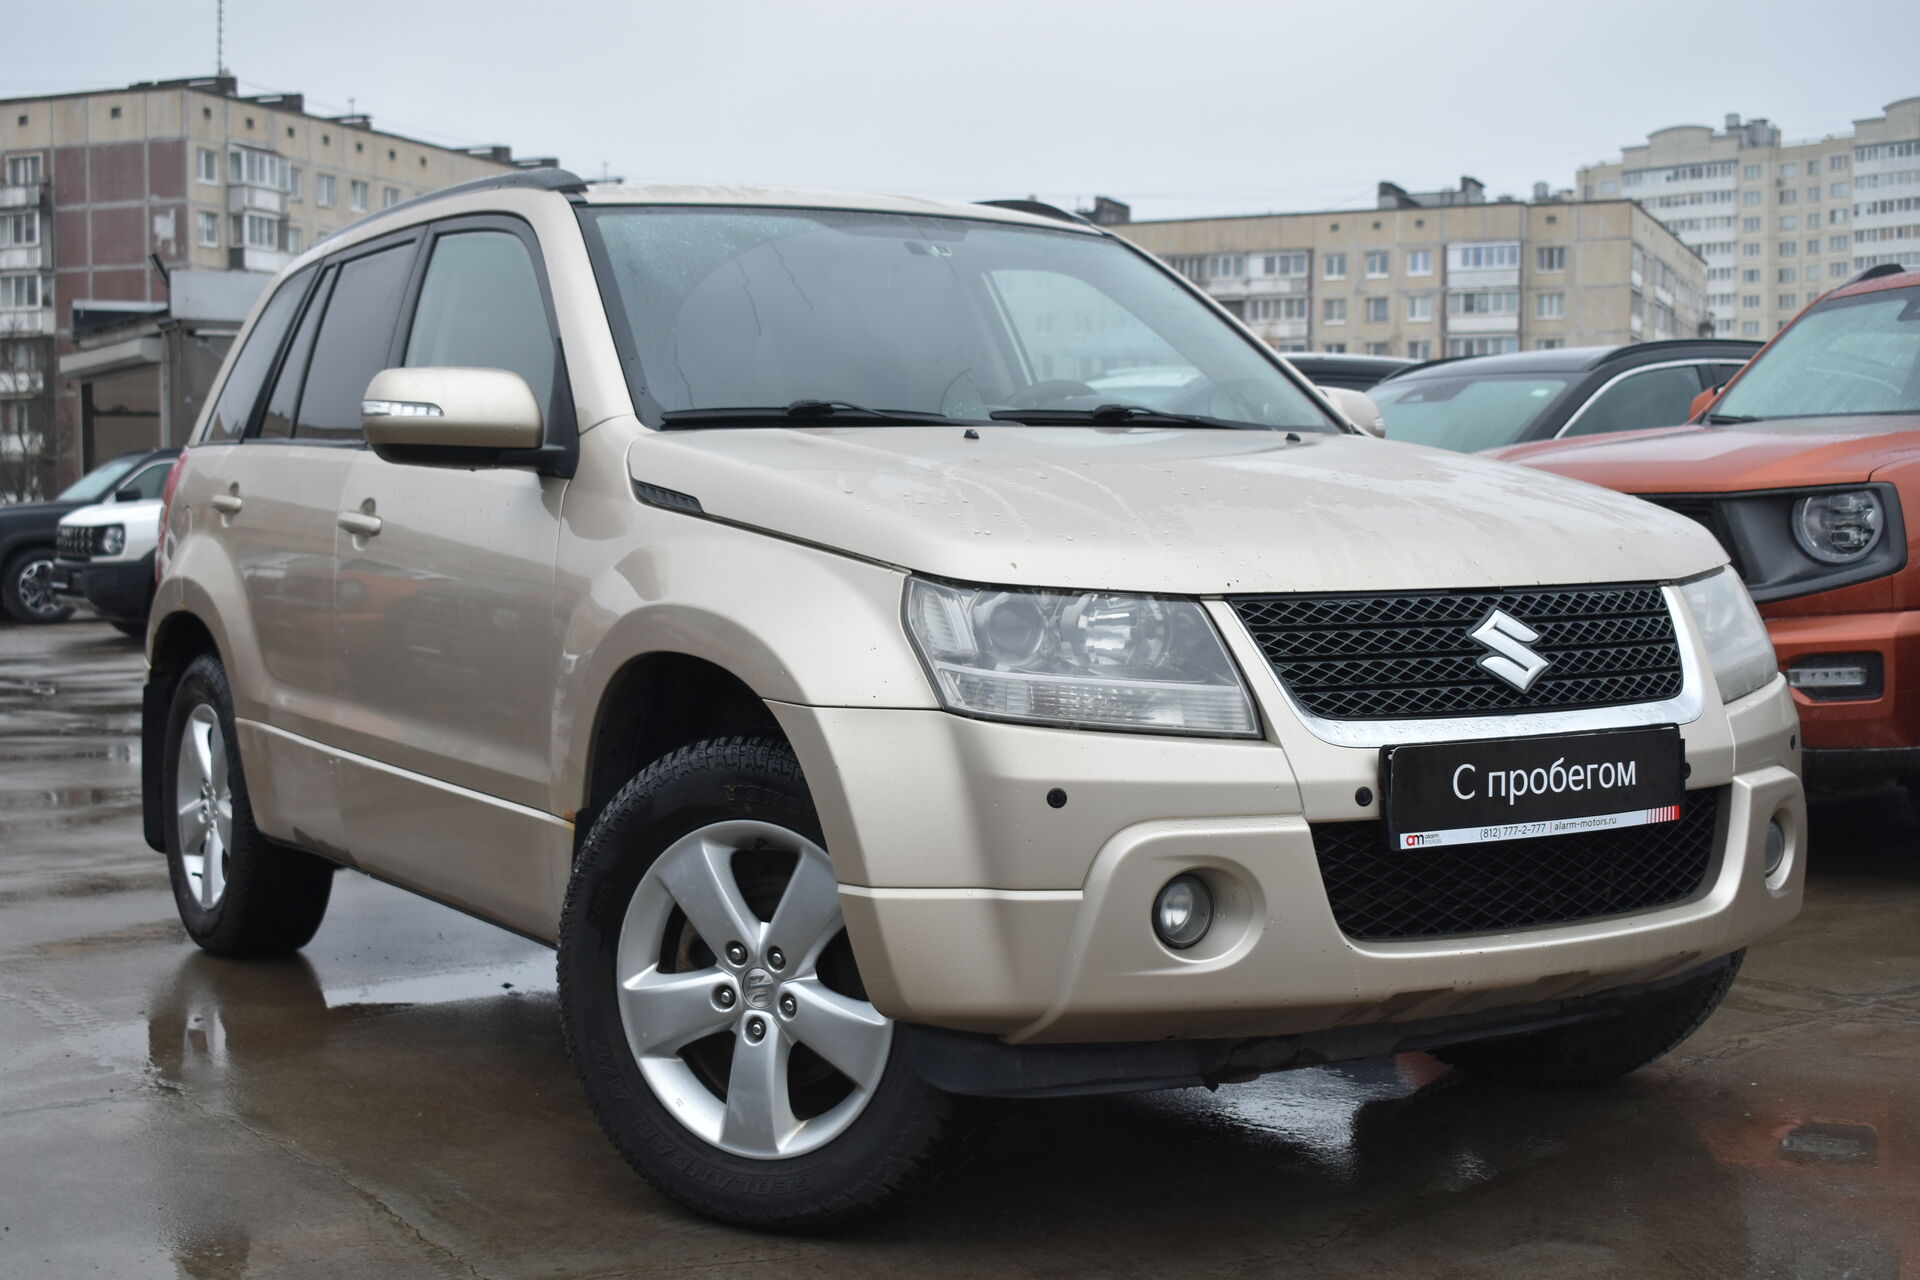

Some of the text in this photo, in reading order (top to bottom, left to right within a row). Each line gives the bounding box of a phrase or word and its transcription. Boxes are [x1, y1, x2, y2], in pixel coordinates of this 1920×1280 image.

[1453, 757, 1637, 805] С пробегом
[722, 783, 810, 817] YOKO
[1406, 834, 1424, 846] am
[1480, 817, 1617, 840] (812) 777-2-777 alarm-motors.ru
[632, 1118, 813, 1197] GEOLANDAR
